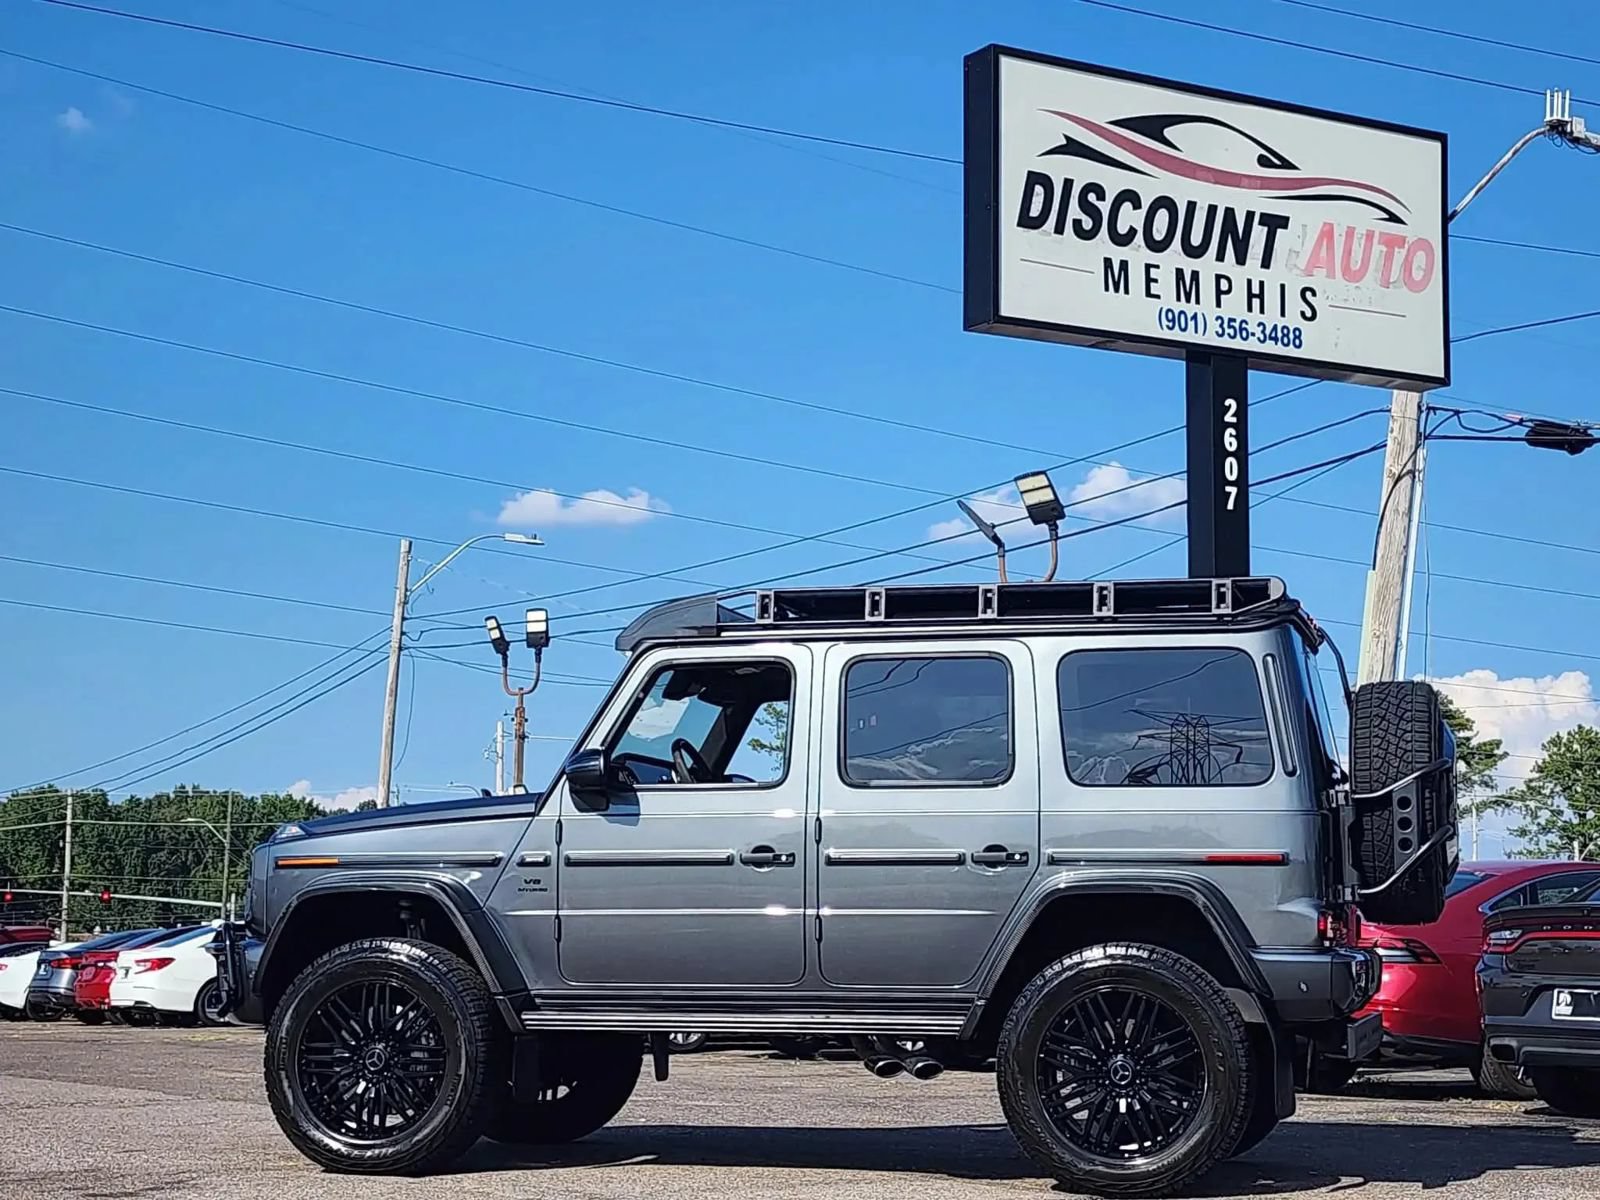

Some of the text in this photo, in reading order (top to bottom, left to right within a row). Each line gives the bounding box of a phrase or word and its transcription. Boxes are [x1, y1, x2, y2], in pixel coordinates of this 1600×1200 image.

[1016, 169, 1436, 294] DISCOUNT AUTO
[1103, 256, 1318, 322] MEMPHIS
[1158, 306, 1304, 349] (901) 356-3488
[1223, 398, 1239, 511] 2607
